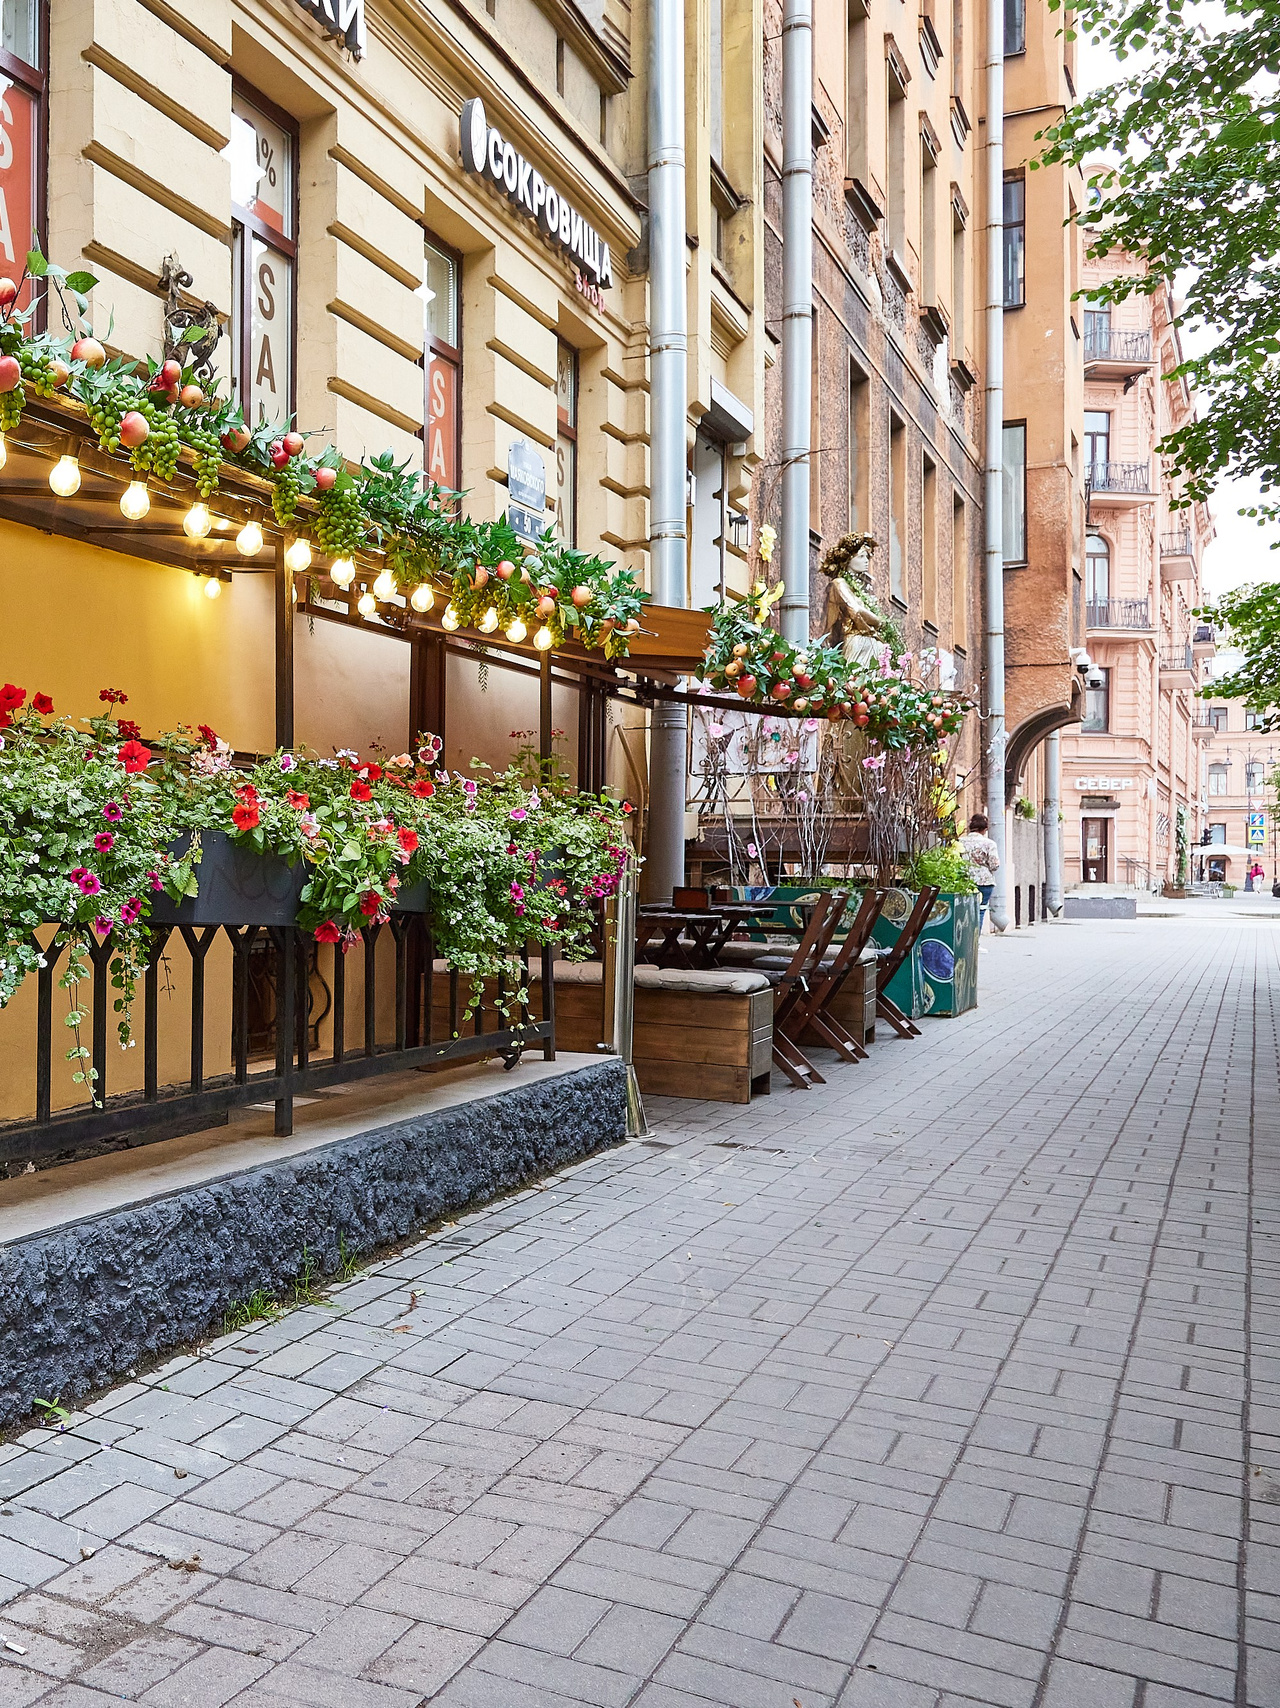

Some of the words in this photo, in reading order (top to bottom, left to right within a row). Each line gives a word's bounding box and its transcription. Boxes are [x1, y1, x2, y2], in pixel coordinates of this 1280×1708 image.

[487, 127, 613, 288] СОКРОВИЩА
[256, 263, 277, 421] SA
[575, 272, 606, 315] shop
[1075, 777, 1133, 791] СЕВЕР
